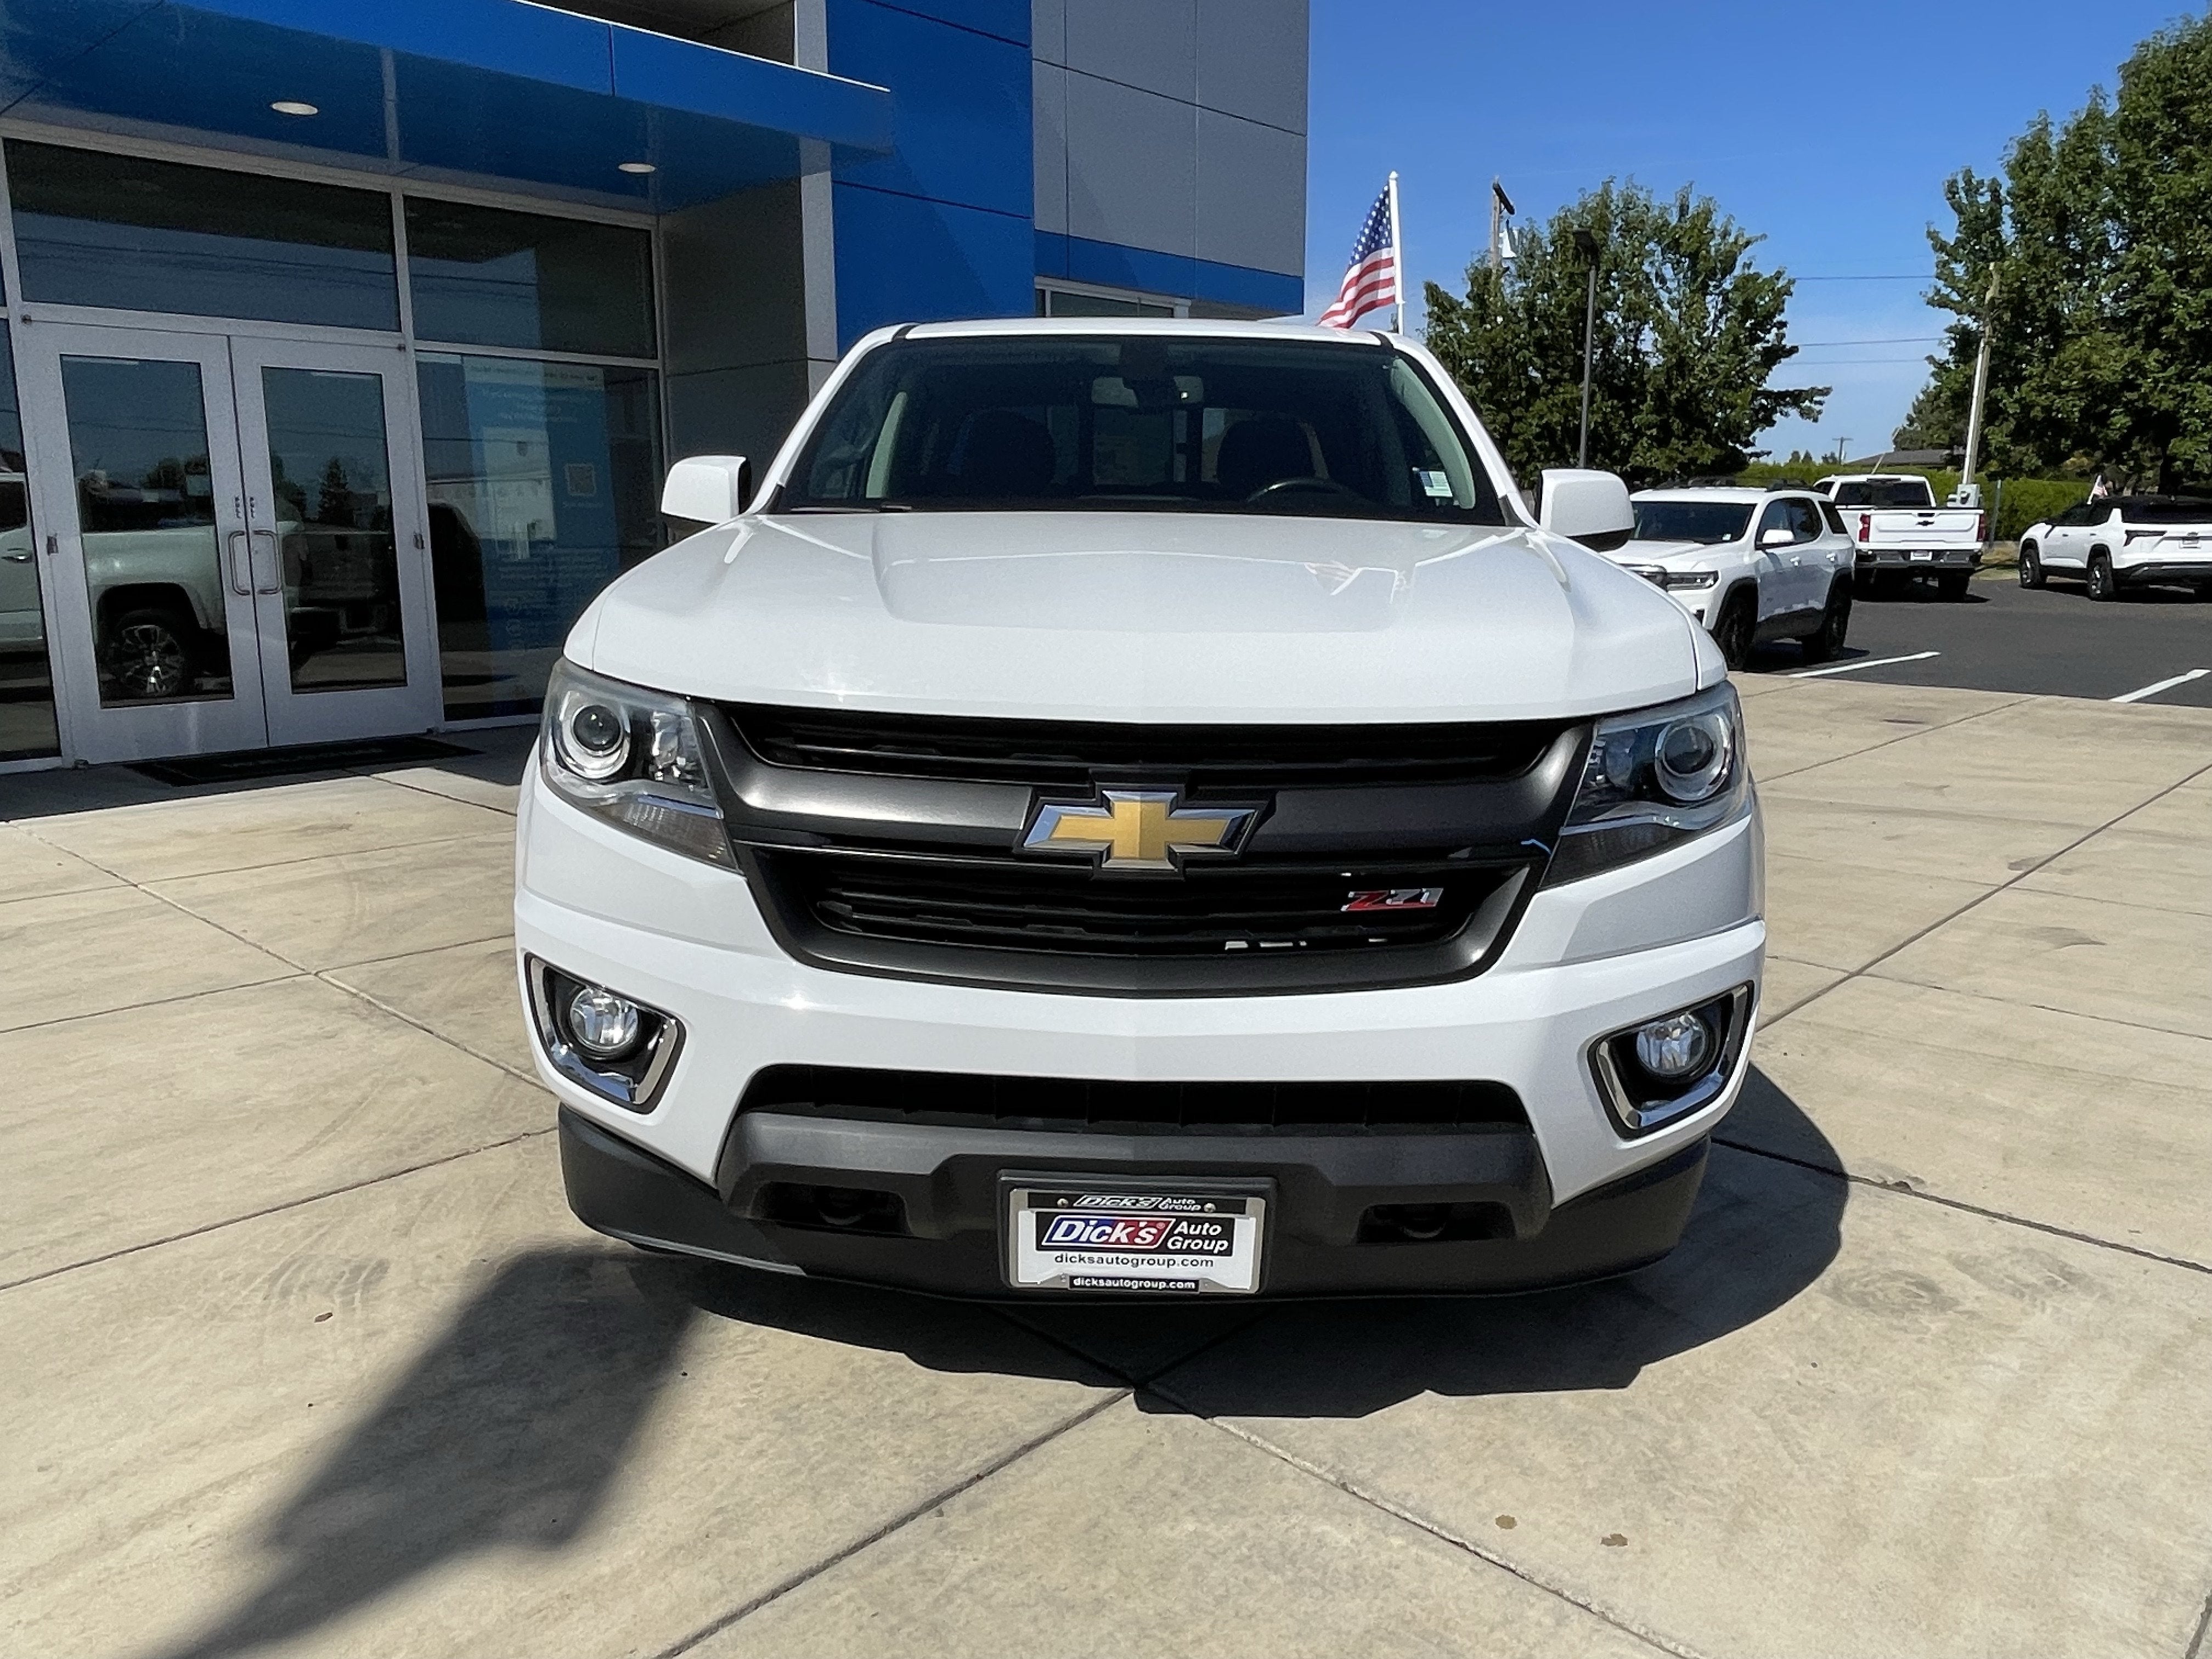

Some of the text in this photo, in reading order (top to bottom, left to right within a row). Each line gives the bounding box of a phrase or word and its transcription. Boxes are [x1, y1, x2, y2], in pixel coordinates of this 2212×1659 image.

[1341, 888, 1444, 912] Z71
[1173, 1221, 1222, 1236] Auto
[1167, 1236, 1229, 1254] Group
[1054, 1253, 1214, 1268] dicksautogroup.com
[1073, 1277, 1196, 1290] dicksautogroup.com
